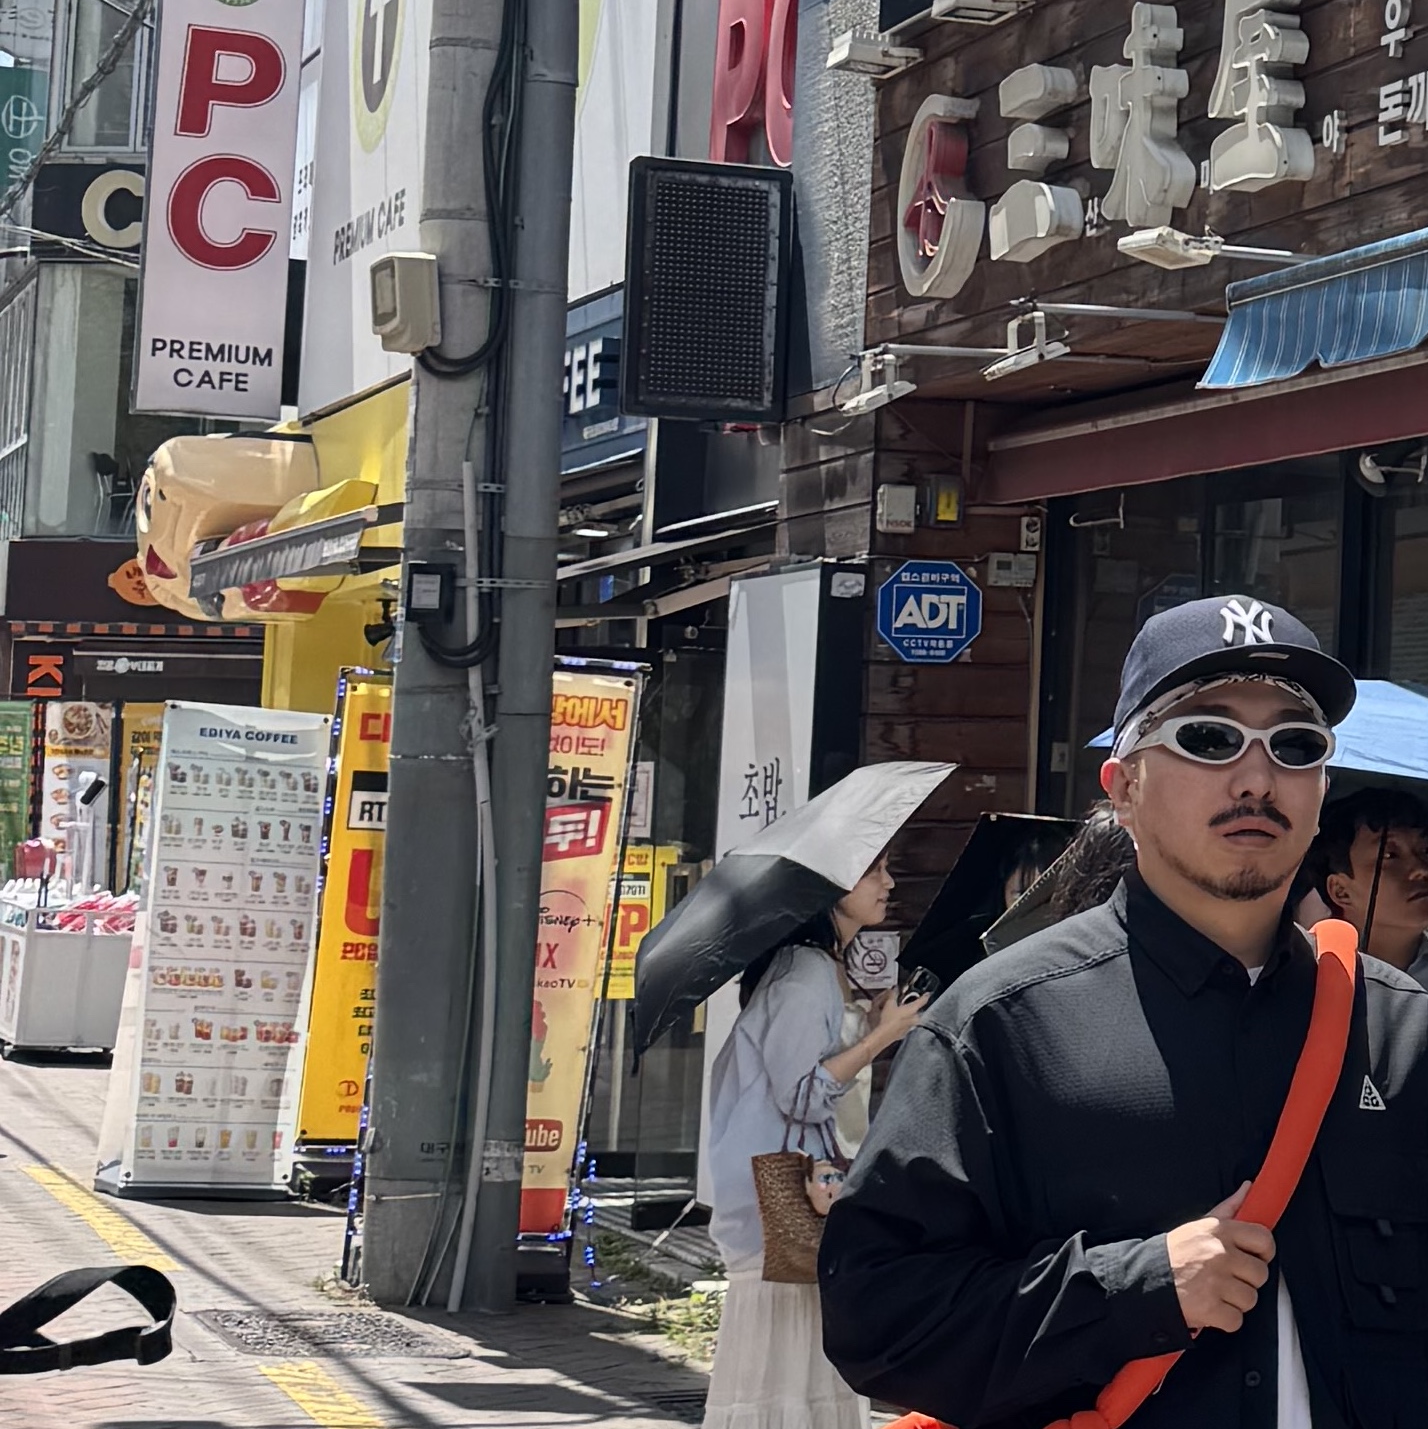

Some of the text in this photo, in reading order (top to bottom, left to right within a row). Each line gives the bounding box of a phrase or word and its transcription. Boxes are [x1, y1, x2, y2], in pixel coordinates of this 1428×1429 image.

[167, 23, 287, 271] PC
[333, 211, 375, 266] PREMIUM
[377, 188, 407, 236] CAFE
[150, 338, 274, 368] PREMIUM
[172, 367, 250, 394] CAFE
[564, 337, 603, 415] EE
[894, 594, 966, 630] ADT
[1220, 599, 1275, 645] NY
[199, 727, 299, 745] EDIYA COFFEE
[547, 765, 615, 801] 하는
[524, 1123, 560, 1148] ube
